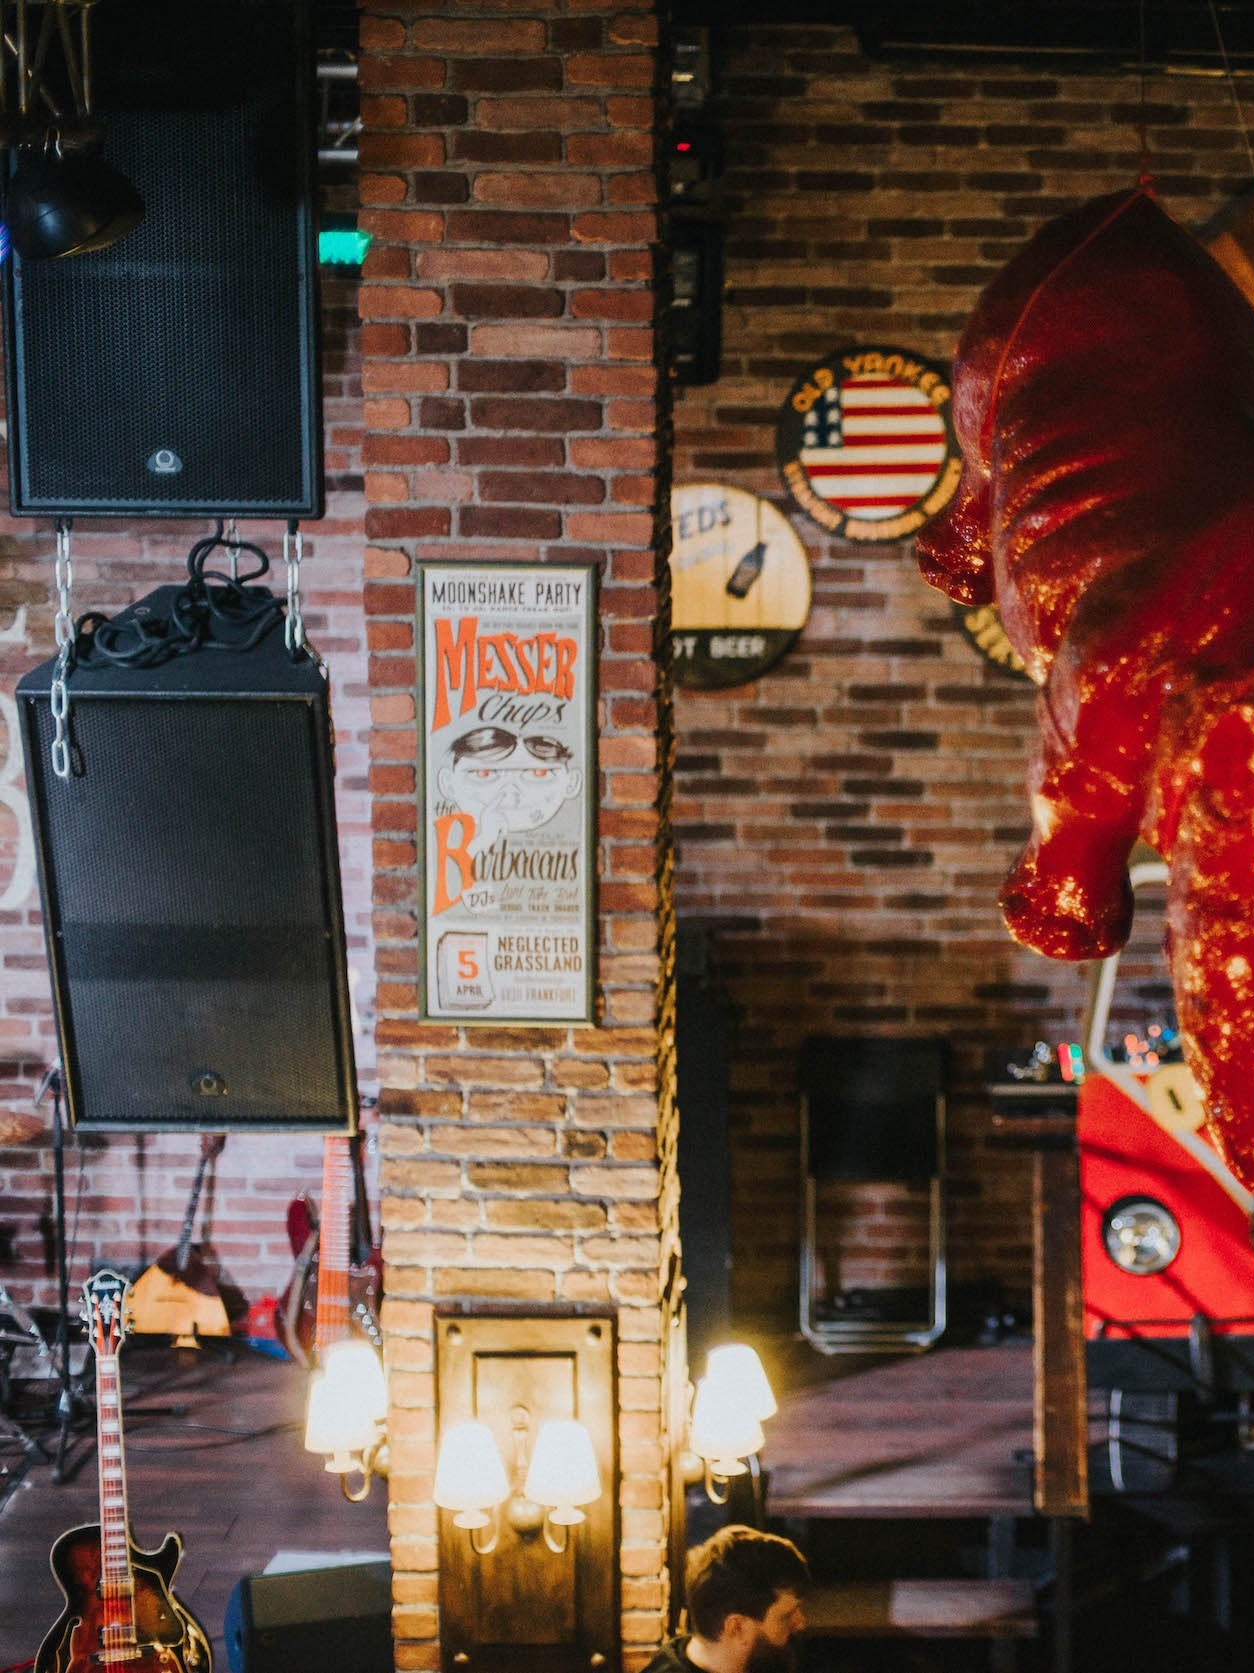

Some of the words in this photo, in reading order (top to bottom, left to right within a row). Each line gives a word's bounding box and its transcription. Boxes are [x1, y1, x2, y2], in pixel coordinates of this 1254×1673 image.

[676, 499, 731, 540] EDS
[432, 581, 525, 605] MOONSHAKE
[536, 582, 581, 606] PARTY
[431, 616, 578, 733] MESSER
[497, 936, 580, 954] NEGLECTED
[456, 950, 479, 980] 5
[494, 955, 583, 972] GRASSLAND
[456, 984, 484, 996] APRIL
